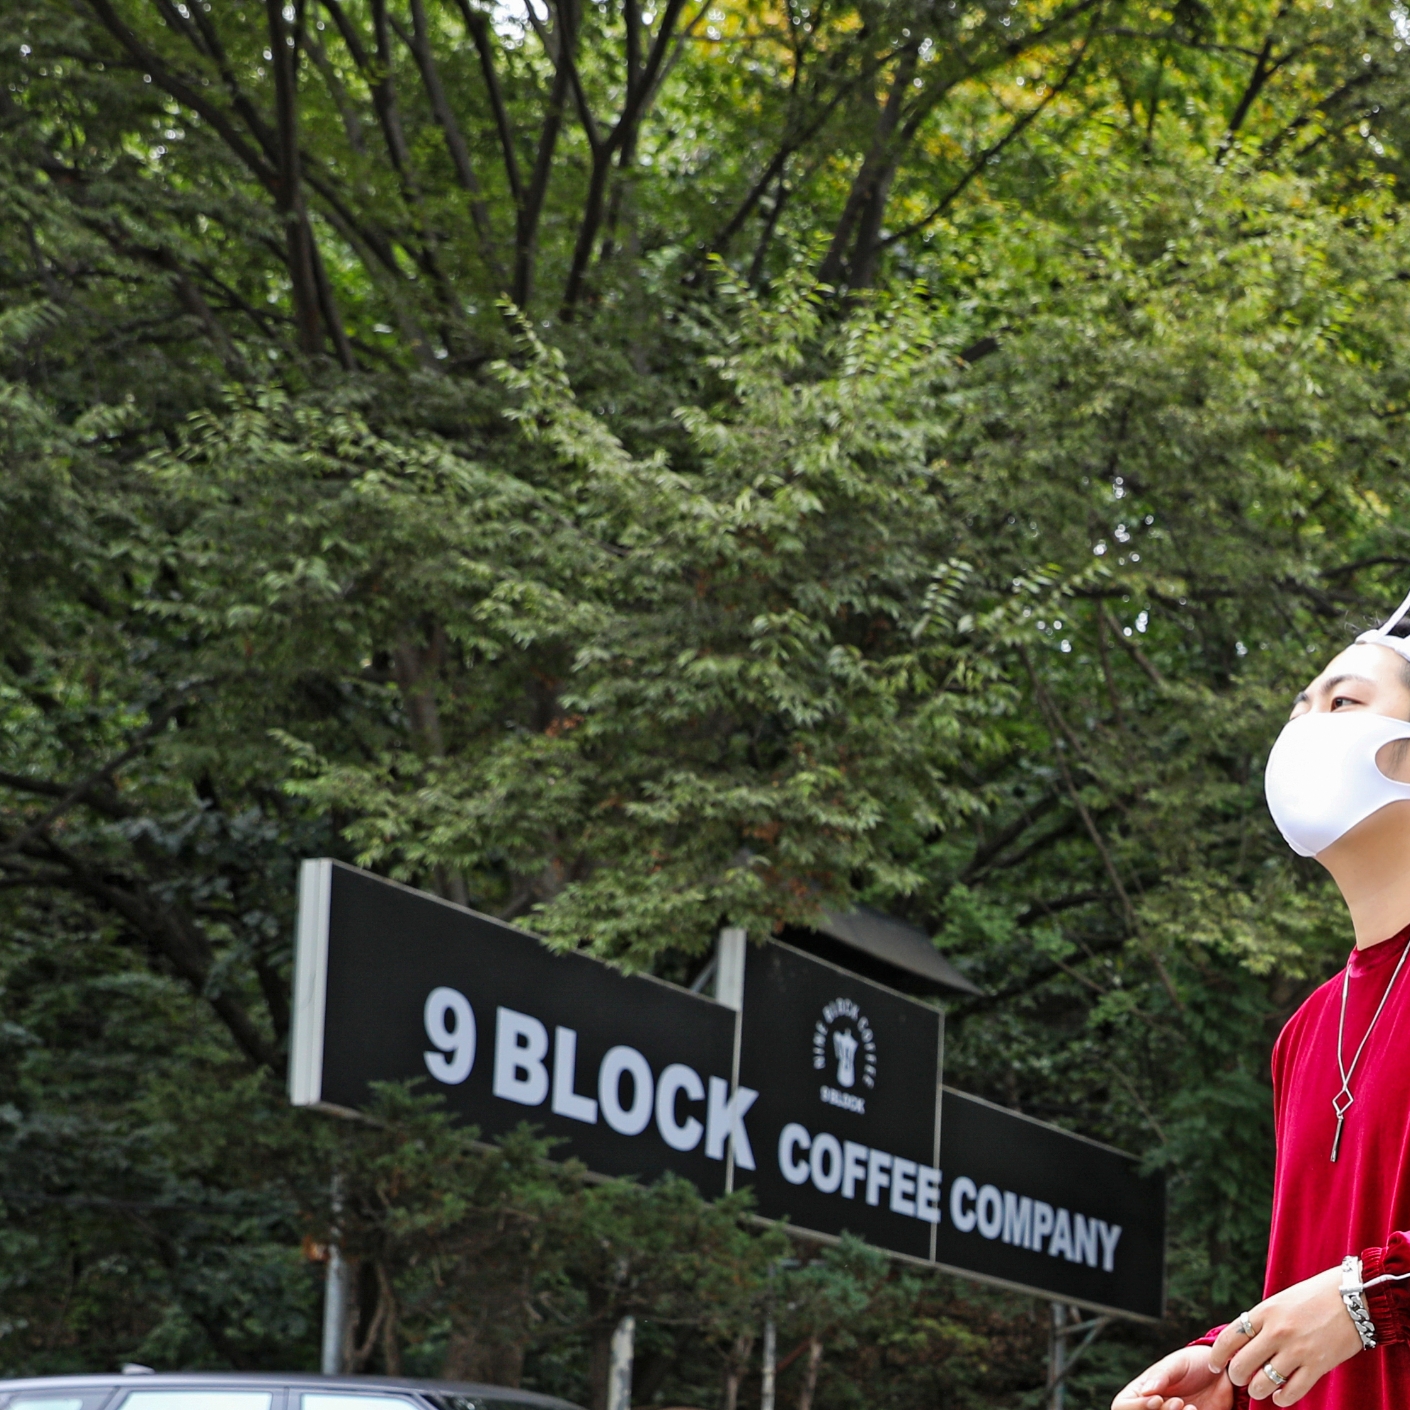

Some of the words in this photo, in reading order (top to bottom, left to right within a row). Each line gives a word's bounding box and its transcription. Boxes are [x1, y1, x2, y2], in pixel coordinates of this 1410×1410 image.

[423, 986, 477, 1085] 9
[492, 1006, 760, 1171] BLOCK
[778, 1122, 942, 1224] COFFEE
[950, 1176, 1122, 1273] COMPANY
